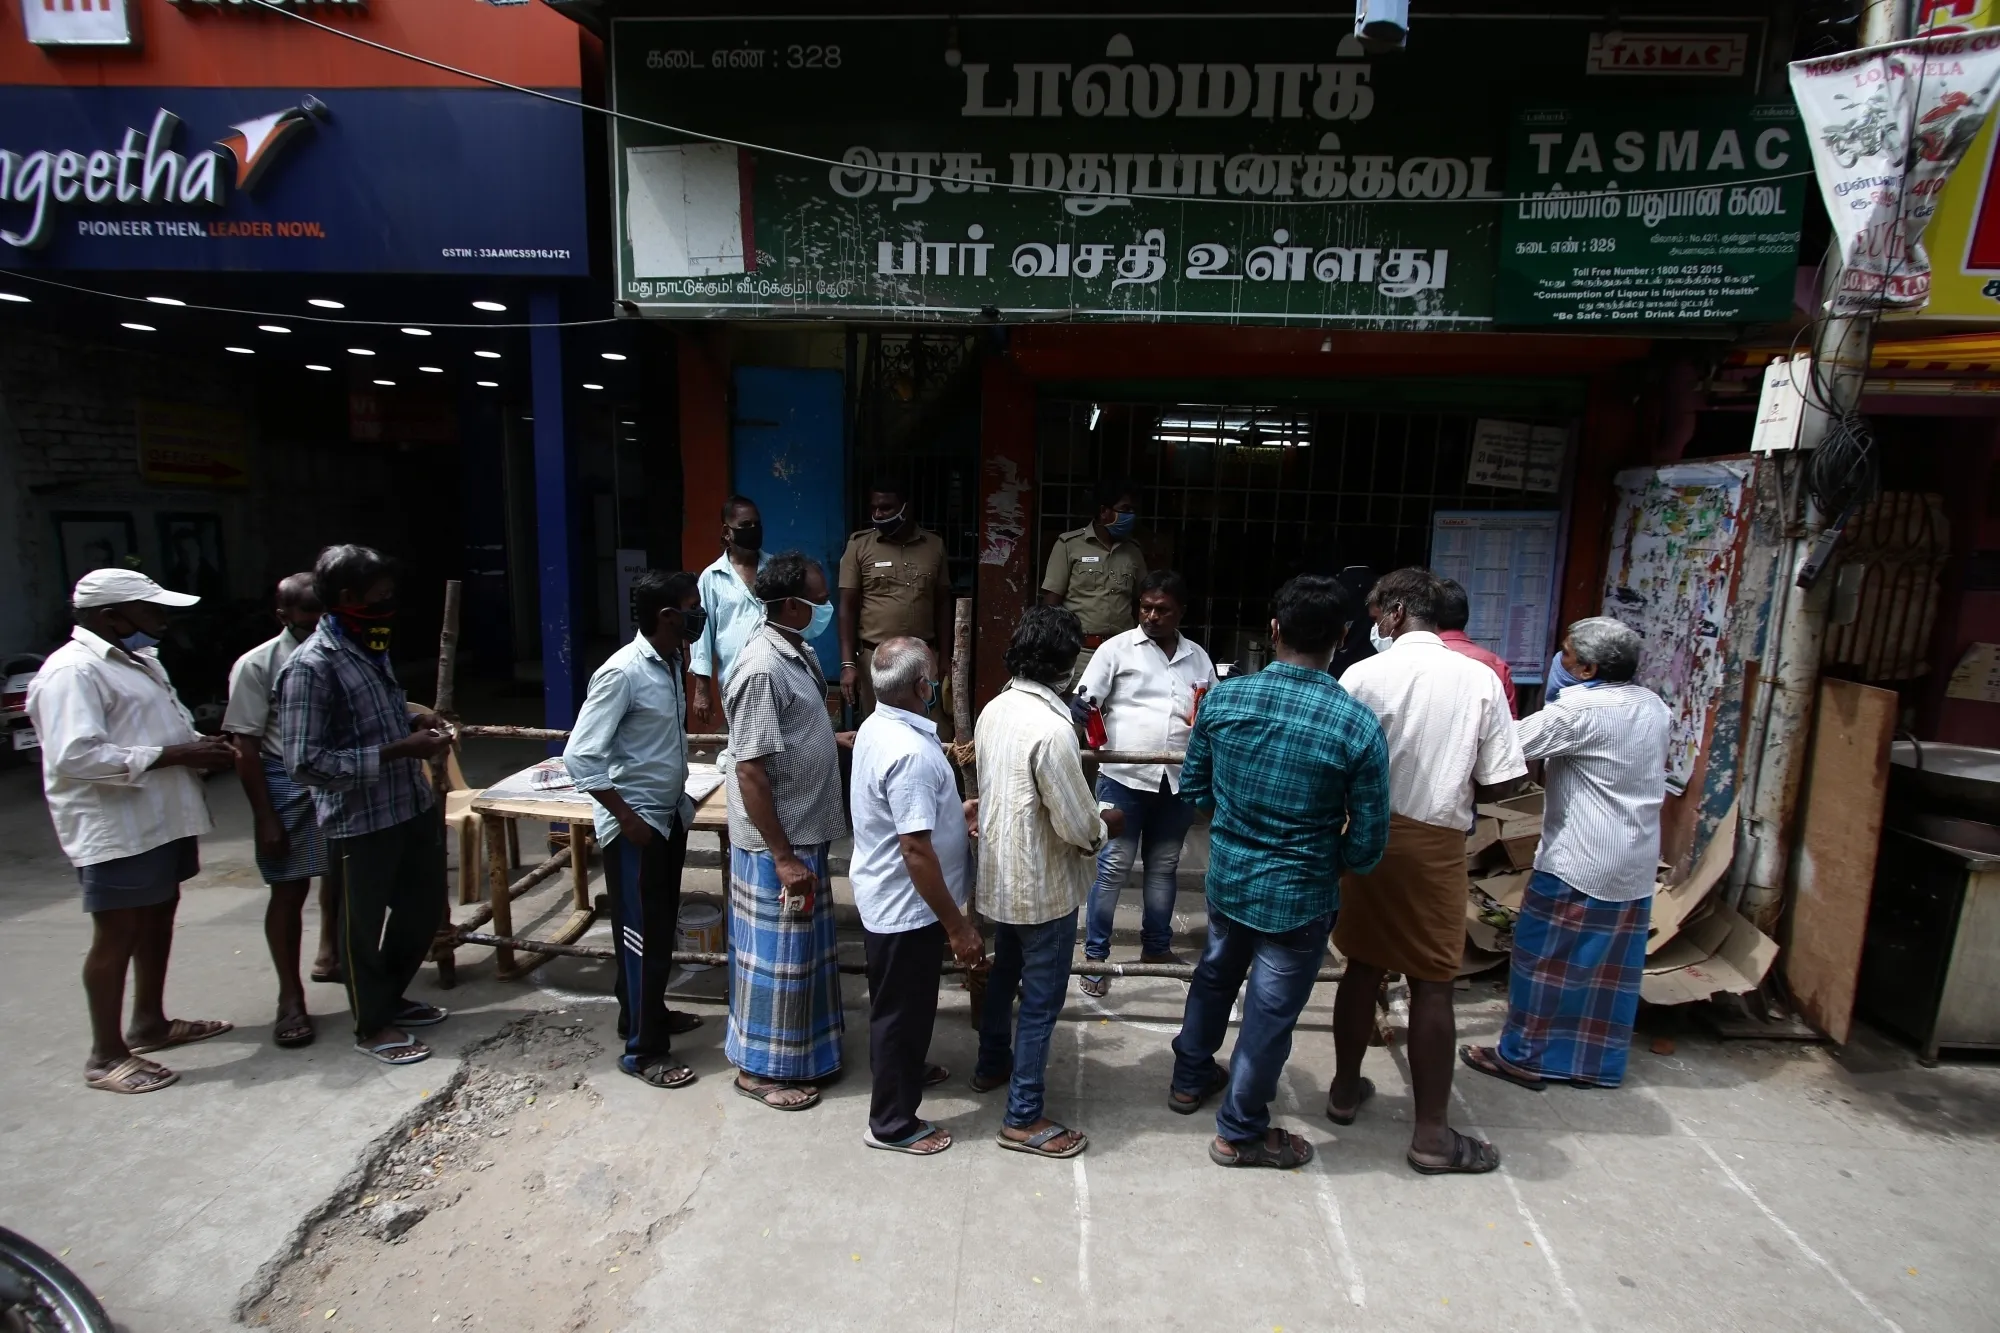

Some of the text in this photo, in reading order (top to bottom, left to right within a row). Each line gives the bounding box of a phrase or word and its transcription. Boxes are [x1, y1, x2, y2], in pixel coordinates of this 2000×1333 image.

[646, 46, 705, 69] கடை
[711, 41, 764, 69] எண்
[786, 45, 842, 69] 328
[1610, 44, 1721, 66] TASMAC
[961, 32, 1375, 121] டாஸ்மாக்
[1805, 56, 1859, 77] MEGA
[1854, 63, 1905, 87] LON
[1529, 127, 1790, 174] TASMAC
[829, 132, 1505, 216] அரசு மதுபானக்கடை
[1519, 181, 1787, 228] டாஸ்மாக் மதுபான கடை
[78, 220, 326, 239] PIONEER THEN. LEADER NOW.
[442, 248, 472, 258] GSTIN
[480, 249, 571, 259] 33AAMCS5916J1Z1
[1515, 241, 1547, 254] கடை
[1551, 235, 1580, 254] எண்
[1589, 237, 1616, 252] 328
[878, 224, 1448, 298] பார் வசதி உள்ளது
[1572, 268, 1589, 277] Toll
[1591, 267, 1611, 277] Free
[1613, 267, 1650, 277] Number
[1656, 266, 1679, 275] 1800
[1681, 265, 1698, 275] 425
[1700, 264, 1723, 274] 2015
[628, 280, 652, 299] மது
[656, 278, 733, 298] நாட்டுக்கும்!
[1634, 275, 1663, 286] உடல்
[1604, 289, 1615, 298] of
[1617, 289, 1649, 299] Liqour
[1651, 288, 1660, 297] is
[1662, 287, 1706, 298] Injurious
[1708, 288, 1719, 296] to
[1576, 311, 1602, 320] Safe
[1612, 310, 1639, 320] Dont
[1645, 309, 1674, 319] Drink
[1677, 309, 1700, 318] And
